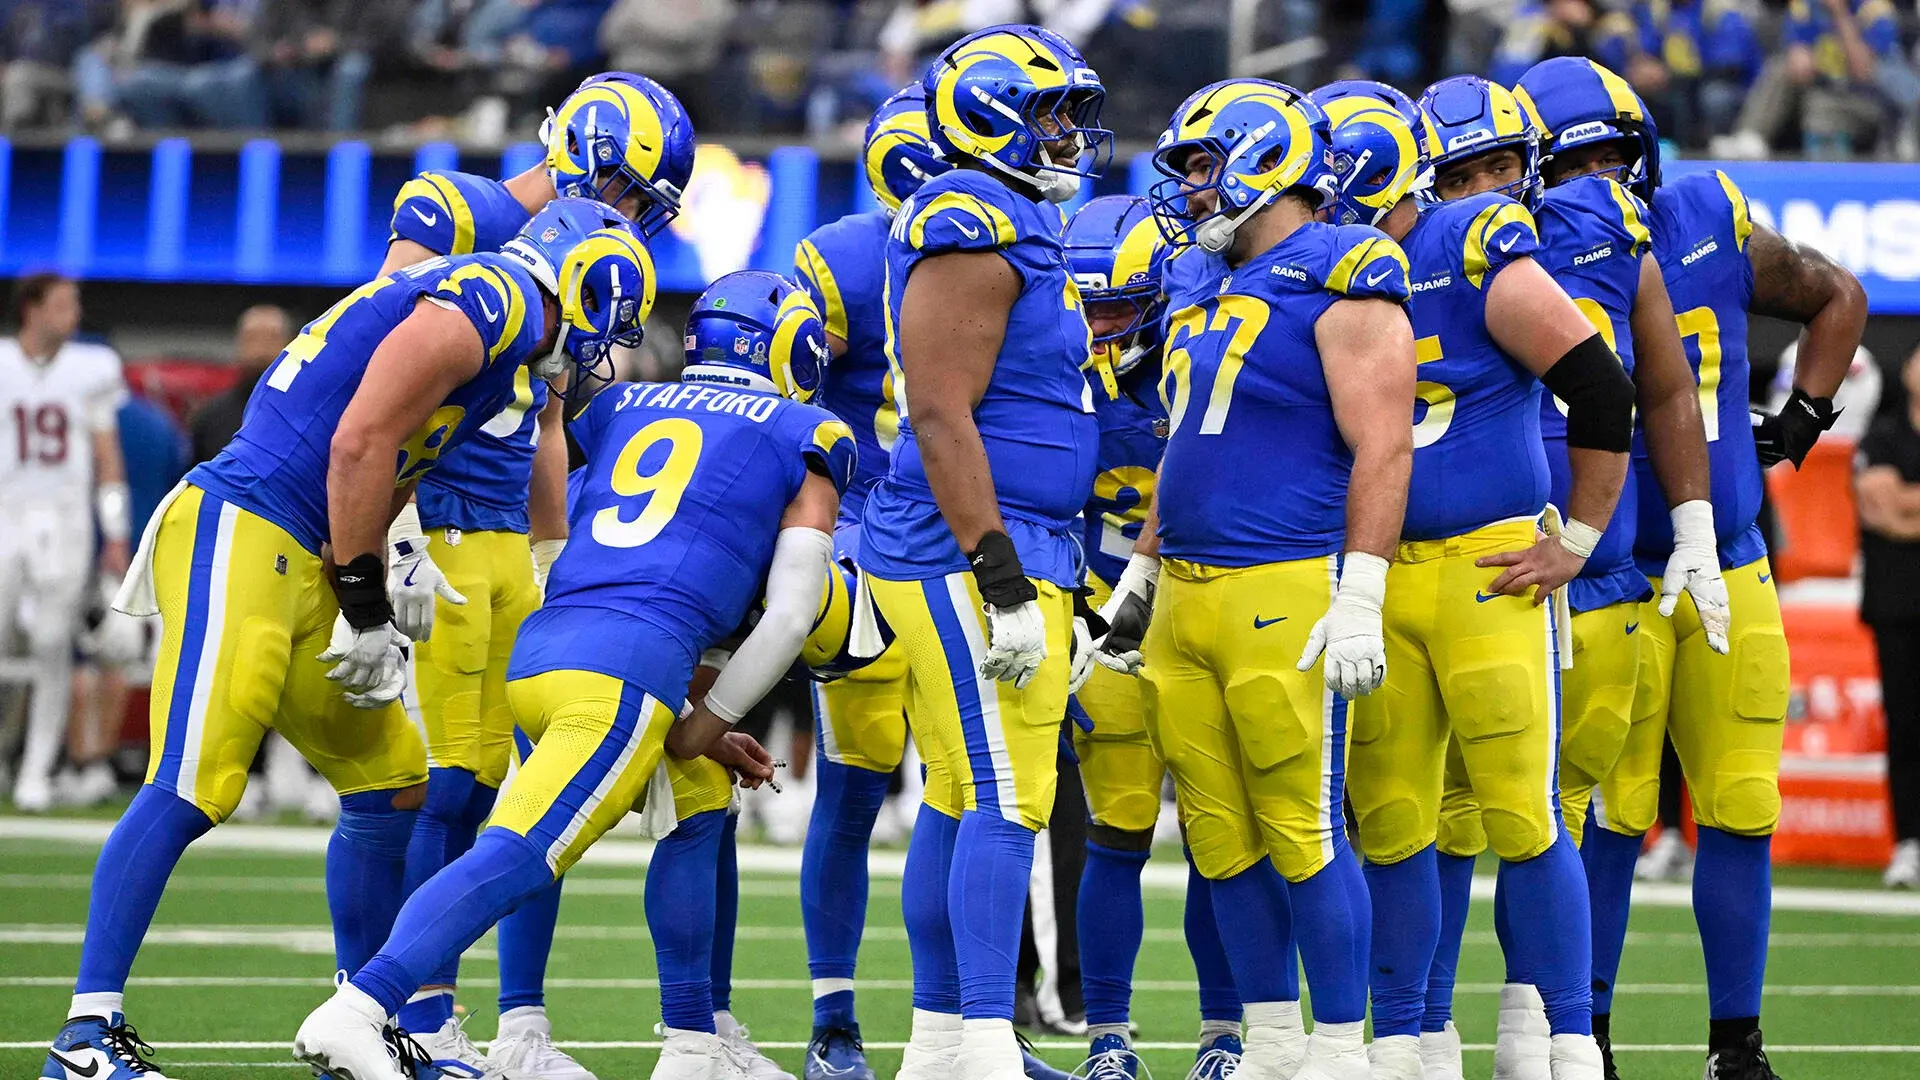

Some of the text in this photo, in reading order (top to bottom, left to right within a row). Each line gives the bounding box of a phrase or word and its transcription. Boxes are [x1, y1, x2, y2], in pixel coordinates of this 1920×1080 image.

[1455, 131, 1483, 145] RAMS
[1565, 125, 1603, 140] RAMS
[1573, 247, 1612, 266] RAMS
[1679, 241, 1718, 266] RAMS
[1270, 265, 1307, 282] RAMS
[1412, 276, 1451, 293] RAMS
[1157, 294, 1270, 441] 67
[614, 383, 780, 424] STAFFORD
[12, 403, 68, 466] 19
[592, 417, 704, 549] 9
